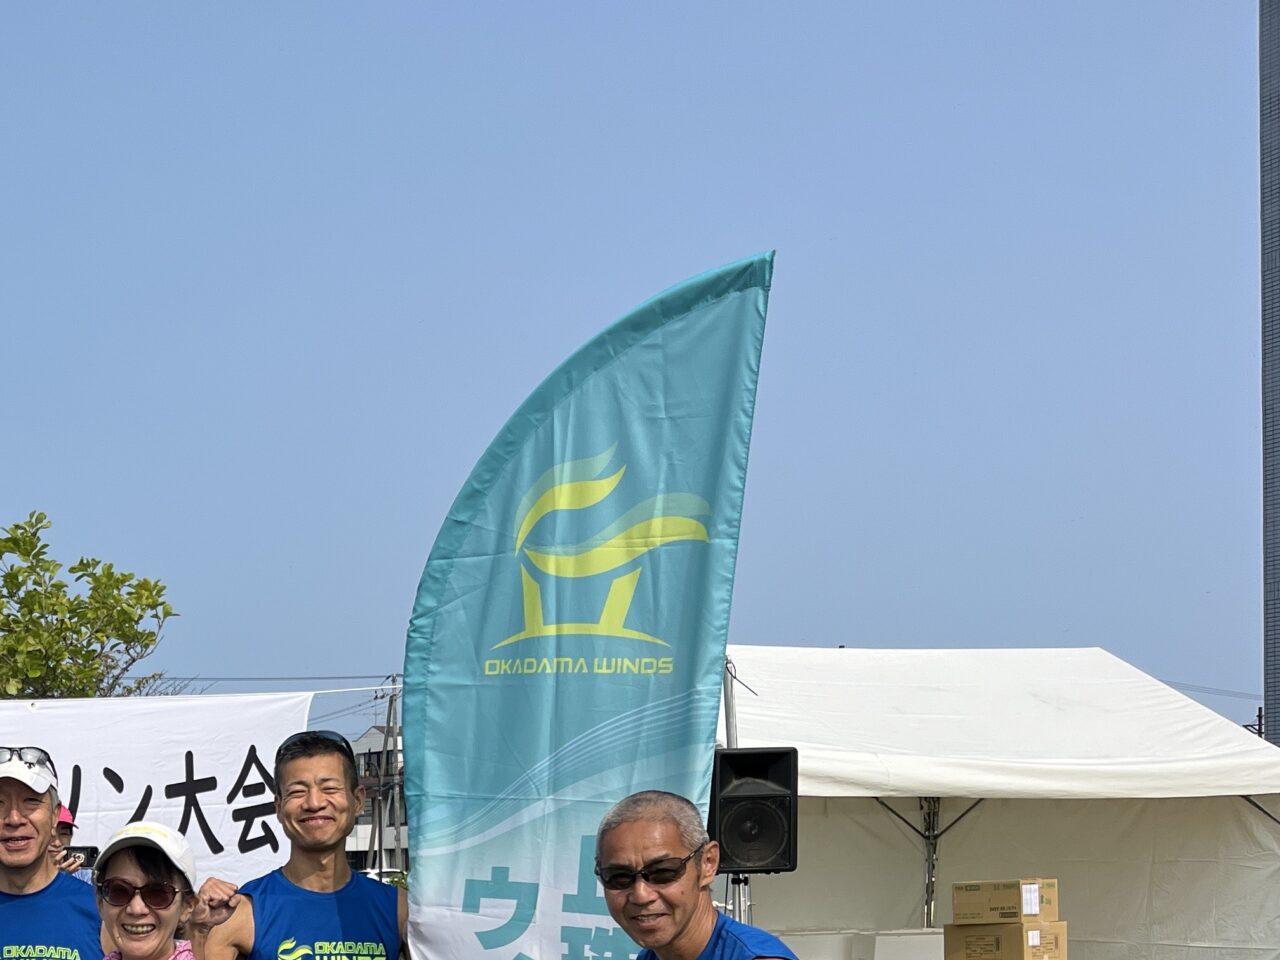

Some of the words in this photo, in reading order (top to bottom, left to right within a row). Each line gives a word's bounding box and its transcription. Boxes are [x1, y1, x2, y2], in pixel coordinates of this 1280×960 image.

[484, 657, 588, 675] OKADAMA
[593, 657, 674, 674] WINDS
[2, 945, 81, 960] OKADAMA
[314, 942, 386, 955] OKADAMA
